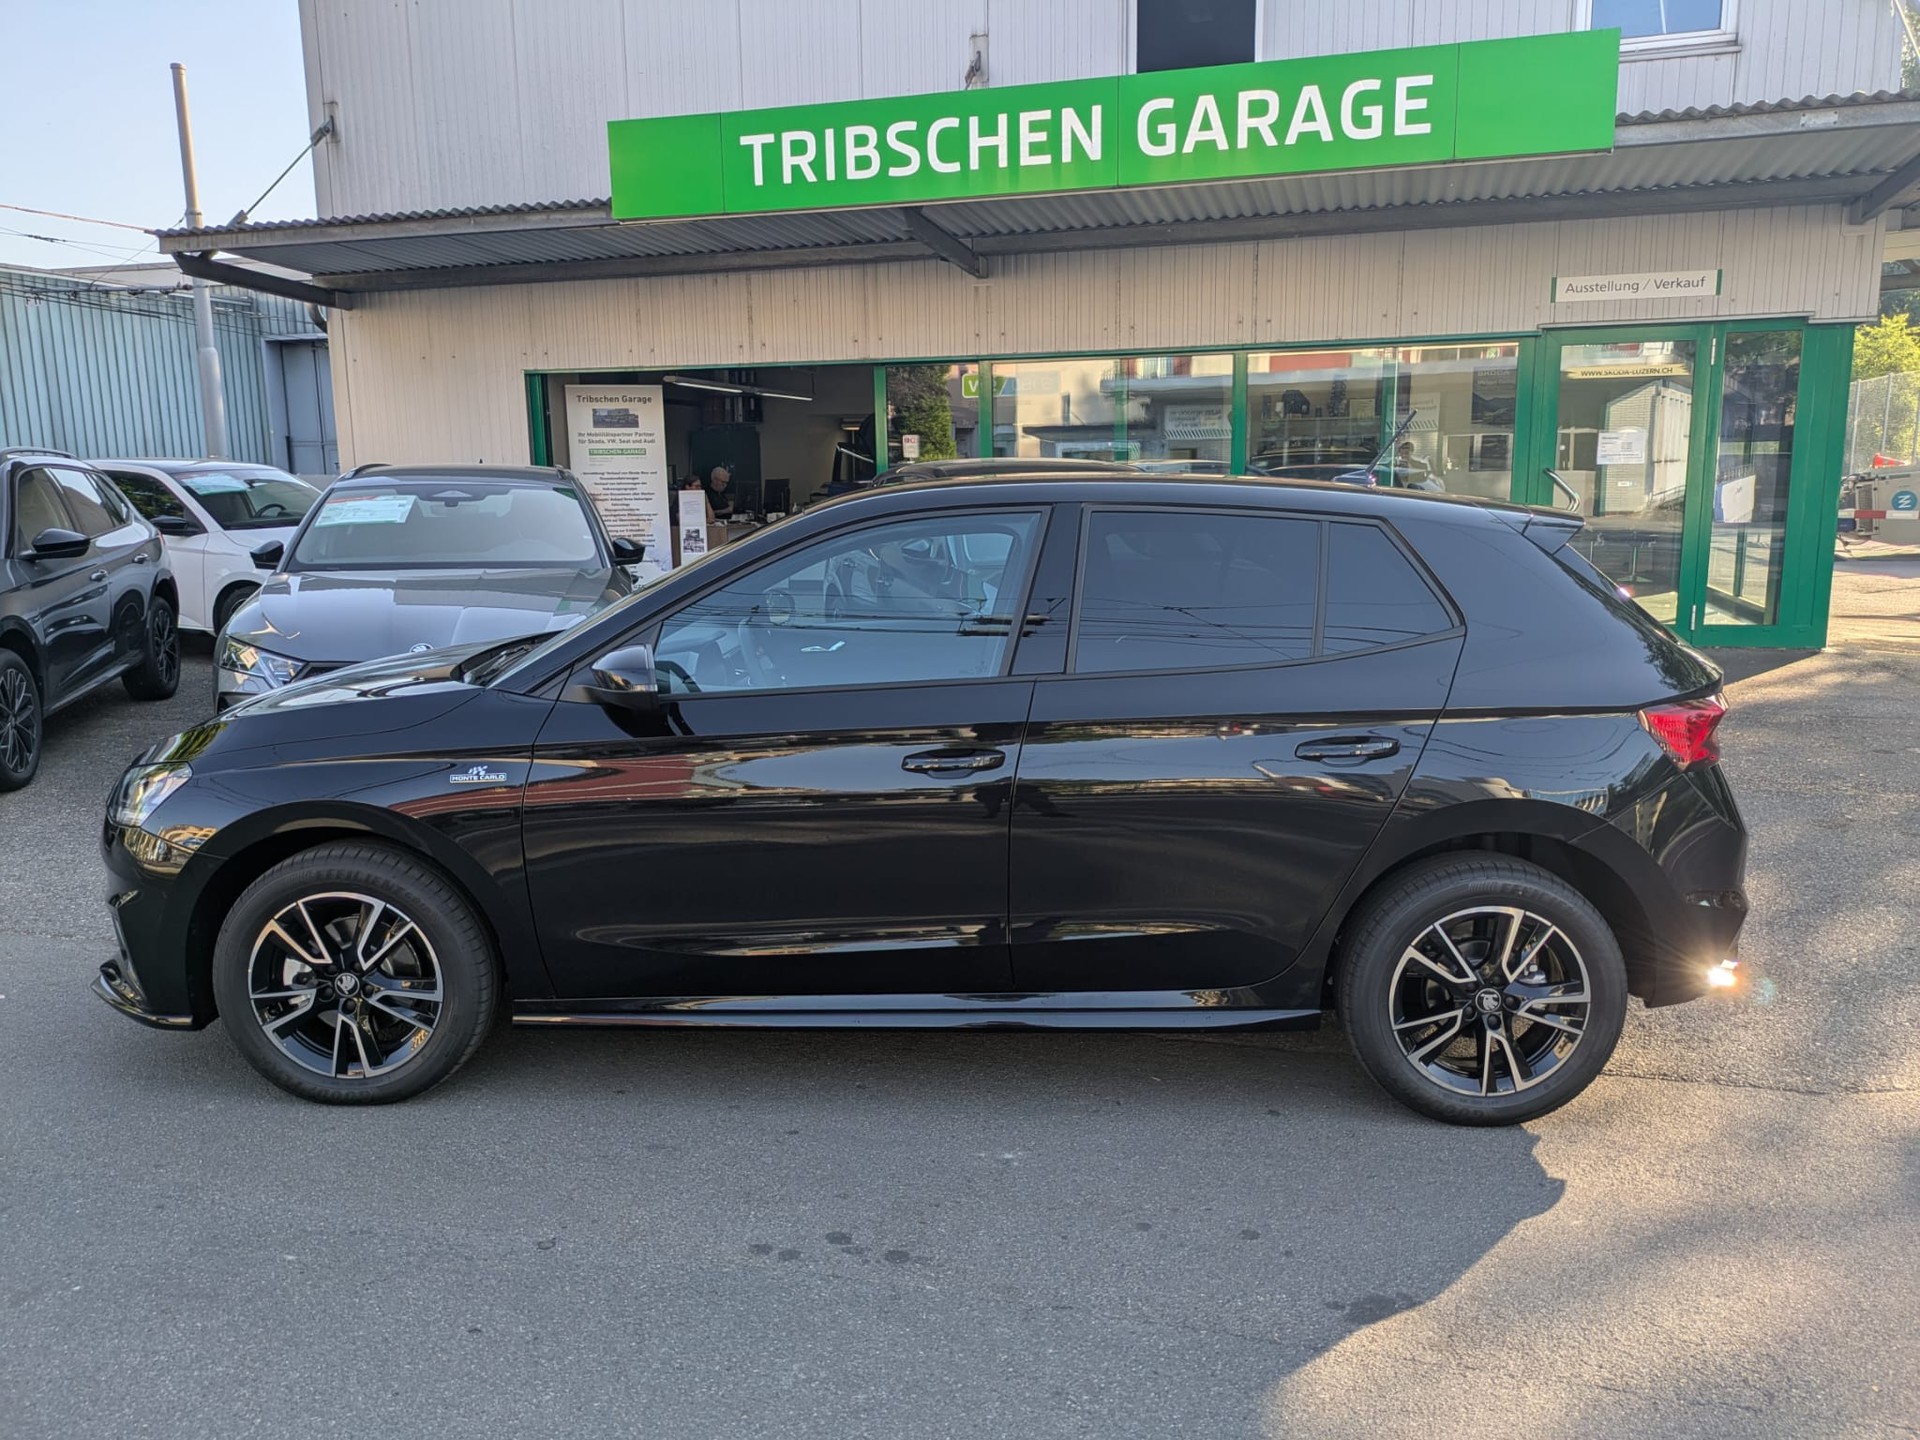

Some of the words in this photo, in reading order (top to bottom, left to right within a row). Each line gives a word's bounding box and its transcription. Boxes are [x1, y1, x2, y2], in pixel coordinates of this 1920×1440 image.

[739, 104, 1102, 186] TRIBSCHEN
[1137, 74, 1434, 157] GARAGE
[1565, 280, 1640, 294] Ausstellung
[1654, 275, 1706, 290] Verkauf
[576, 394, 620, 404] Tribschen
[621, 394, 653, 405] Garage
